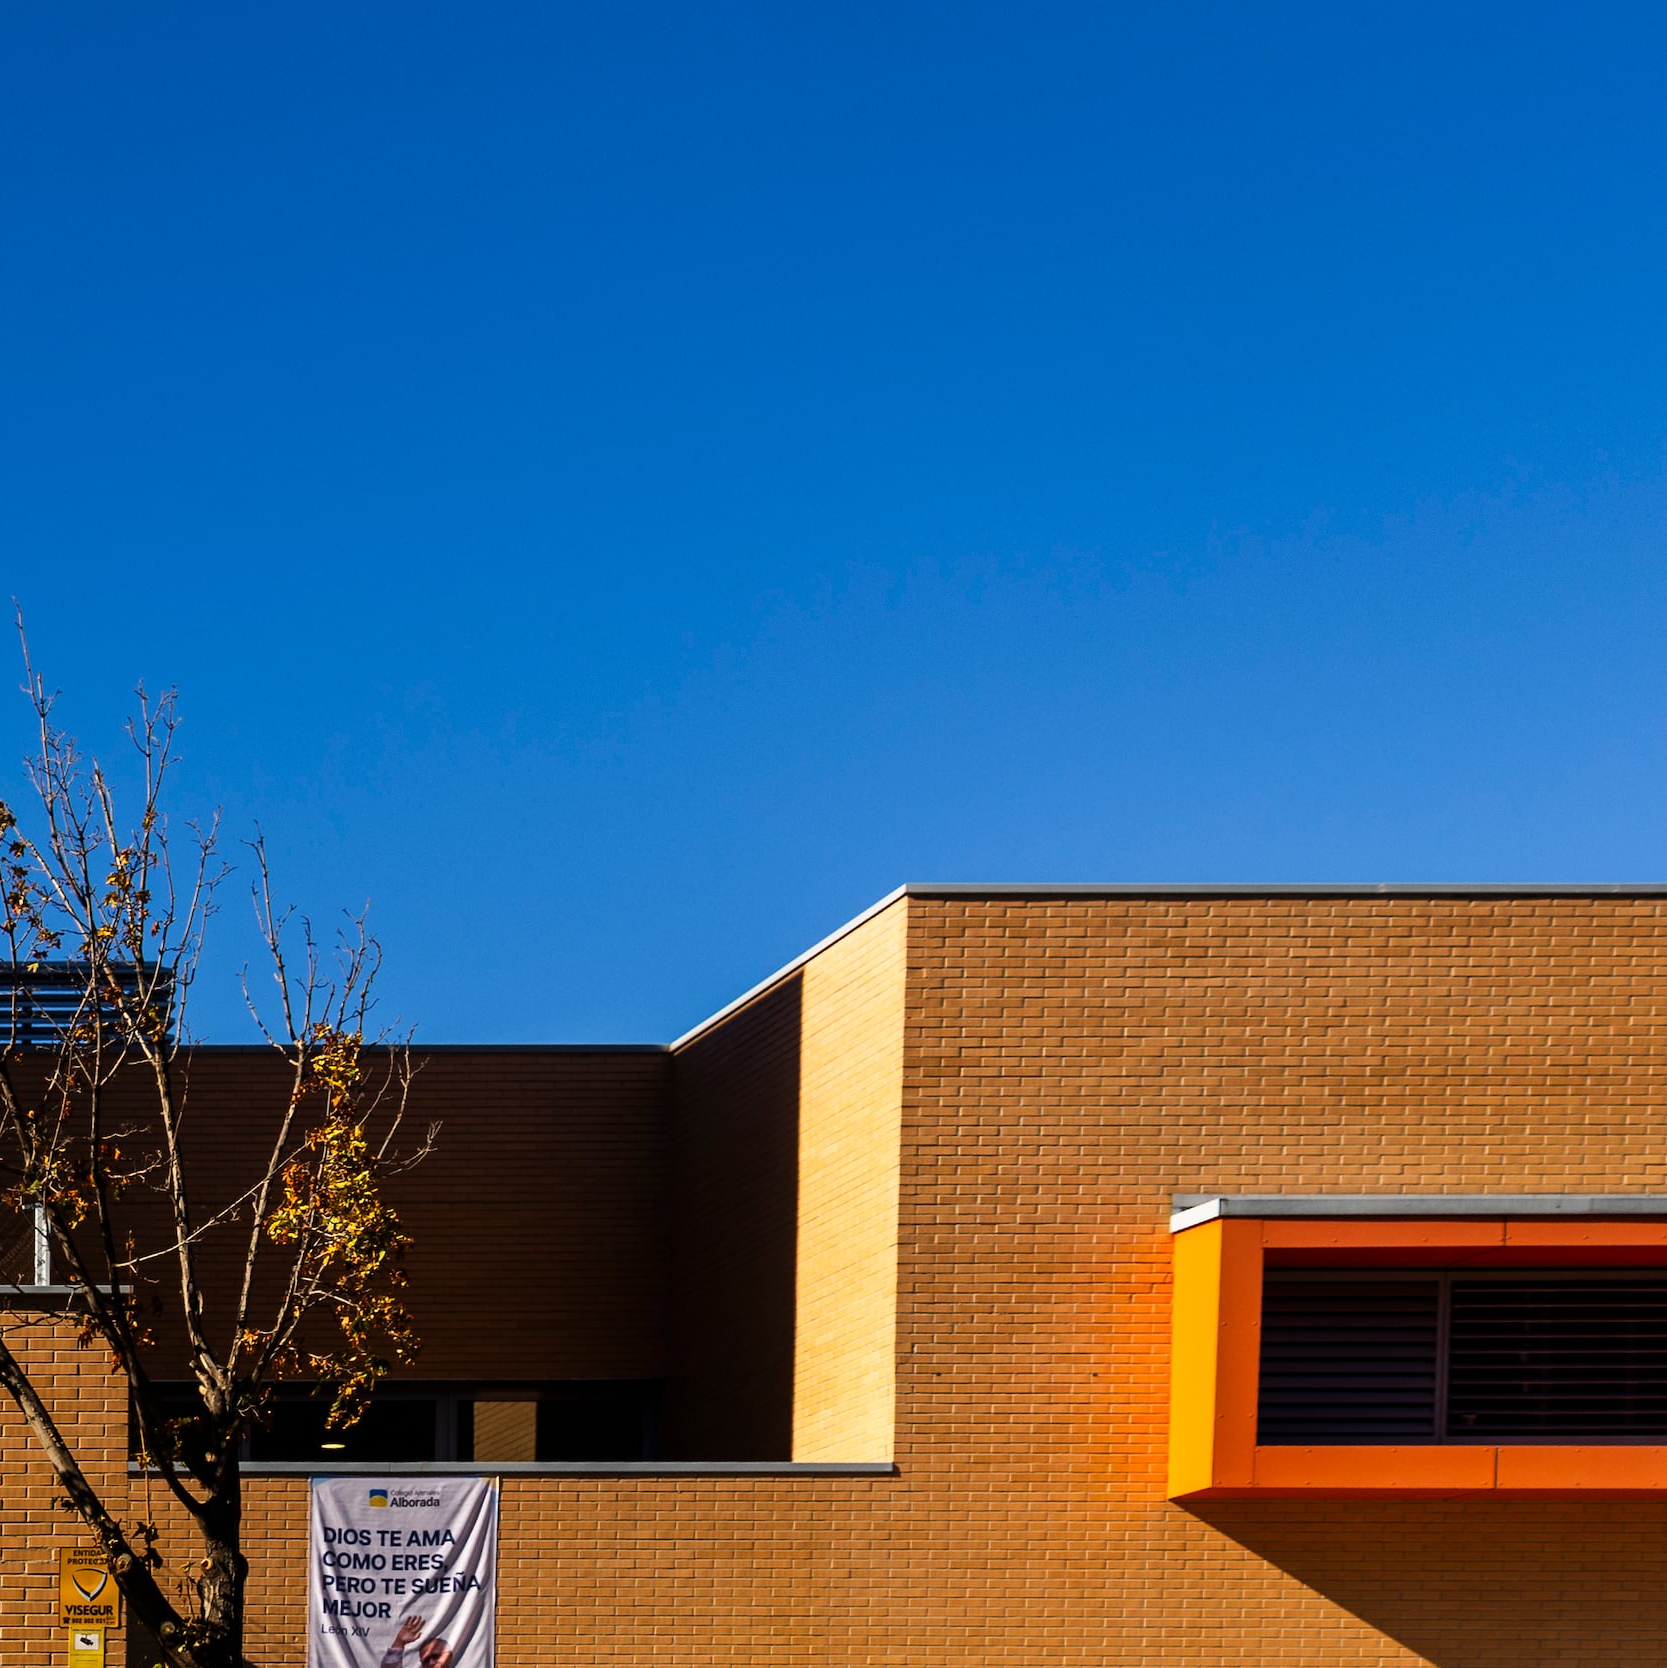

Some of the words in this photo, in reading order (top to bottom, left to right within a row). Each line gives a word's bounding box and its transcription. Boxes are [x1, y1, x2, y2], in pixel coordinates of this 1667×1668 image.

[389, 1496, 440, 1507] Alborada
[323, 1526, 372, 1546] DIOS
[376, 1530, 402, 1547] TE
[406, 1529, 455, 1547] AMA
[73, 1549, 102, 1557] ENTIDA
[322, 1551, 386, 1571] COMO
[391, 1553, 449, 1572] ERES,
[322, 1574, 376, 1594] PERO
[381, 1578, 406, 1595] TE
[411, 1571, 482, 1595] SUEÑA
[65, 1604, 114, 1616] VISEGUR
[322, 1598, 392, 1619] MEJOR
[321, 1624, 348, 1637] León
[351, 1625, 371, 1638] XIV
